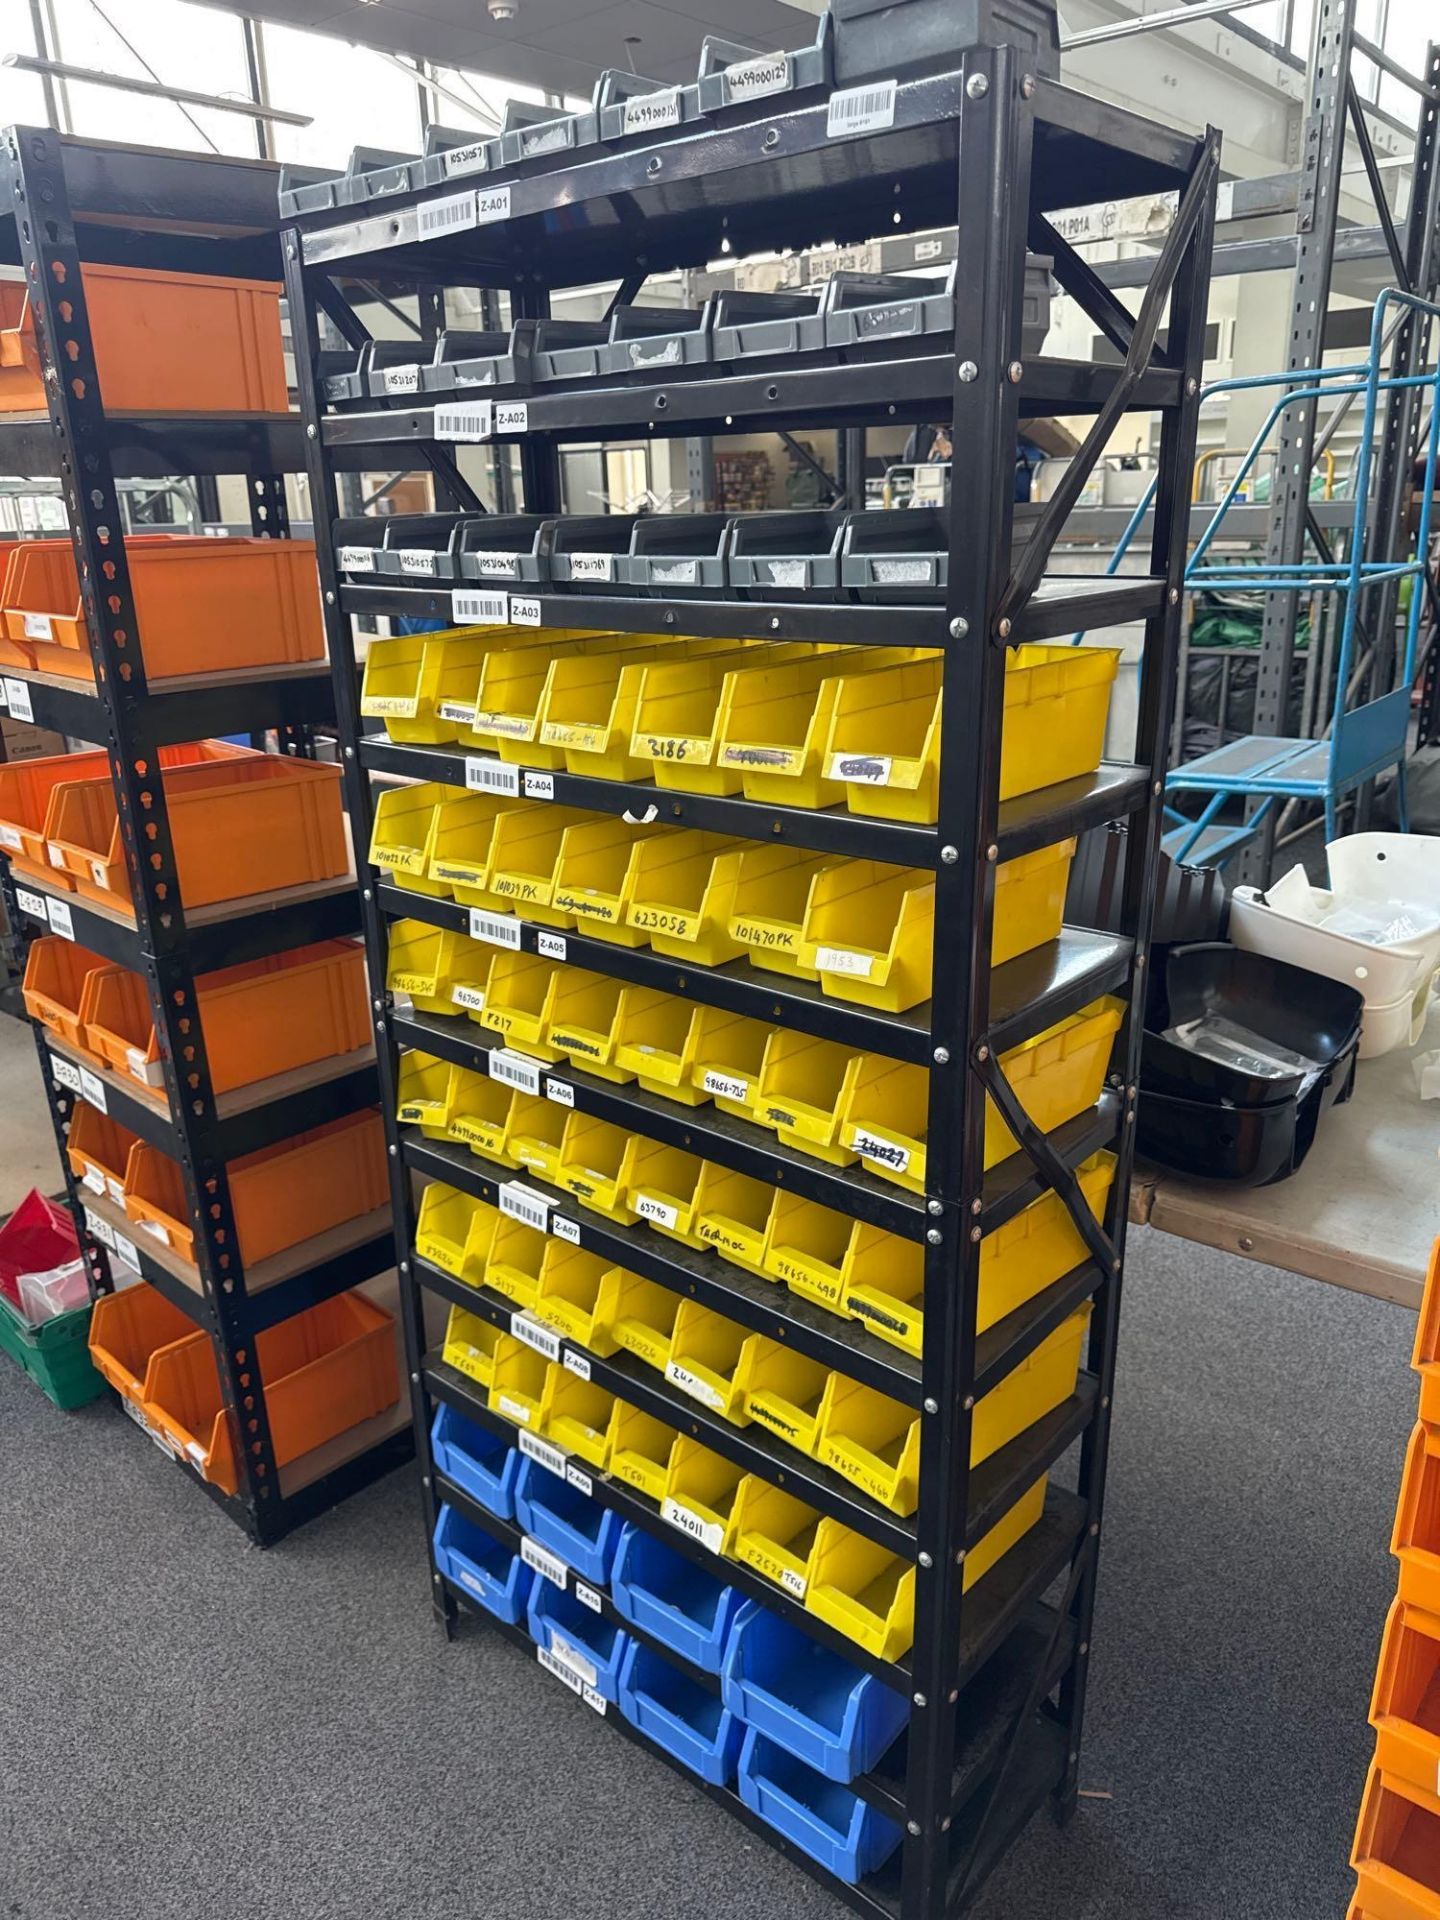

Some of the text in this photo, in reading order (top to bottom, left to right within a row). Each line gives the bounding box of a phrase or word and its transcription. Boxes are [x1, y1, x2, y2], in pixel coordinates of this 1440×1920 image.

[480, 198, 508, 212] Z-A01
[498, 411, 526, 424] Z-A02
[512, 605, 540, 618] Z-A03
[647, 738, 688, 760] 3186
[526, 779, 552, 792] Z-A04
[634, 911, 688, 935] 623058
[540, 938, 565, 953] Z-A05
[547, 1084, 573, 1100] Z-A06
[639, 1202, 666, 1219] 63790
[554, 1221, 578, 1237] Z-A07
